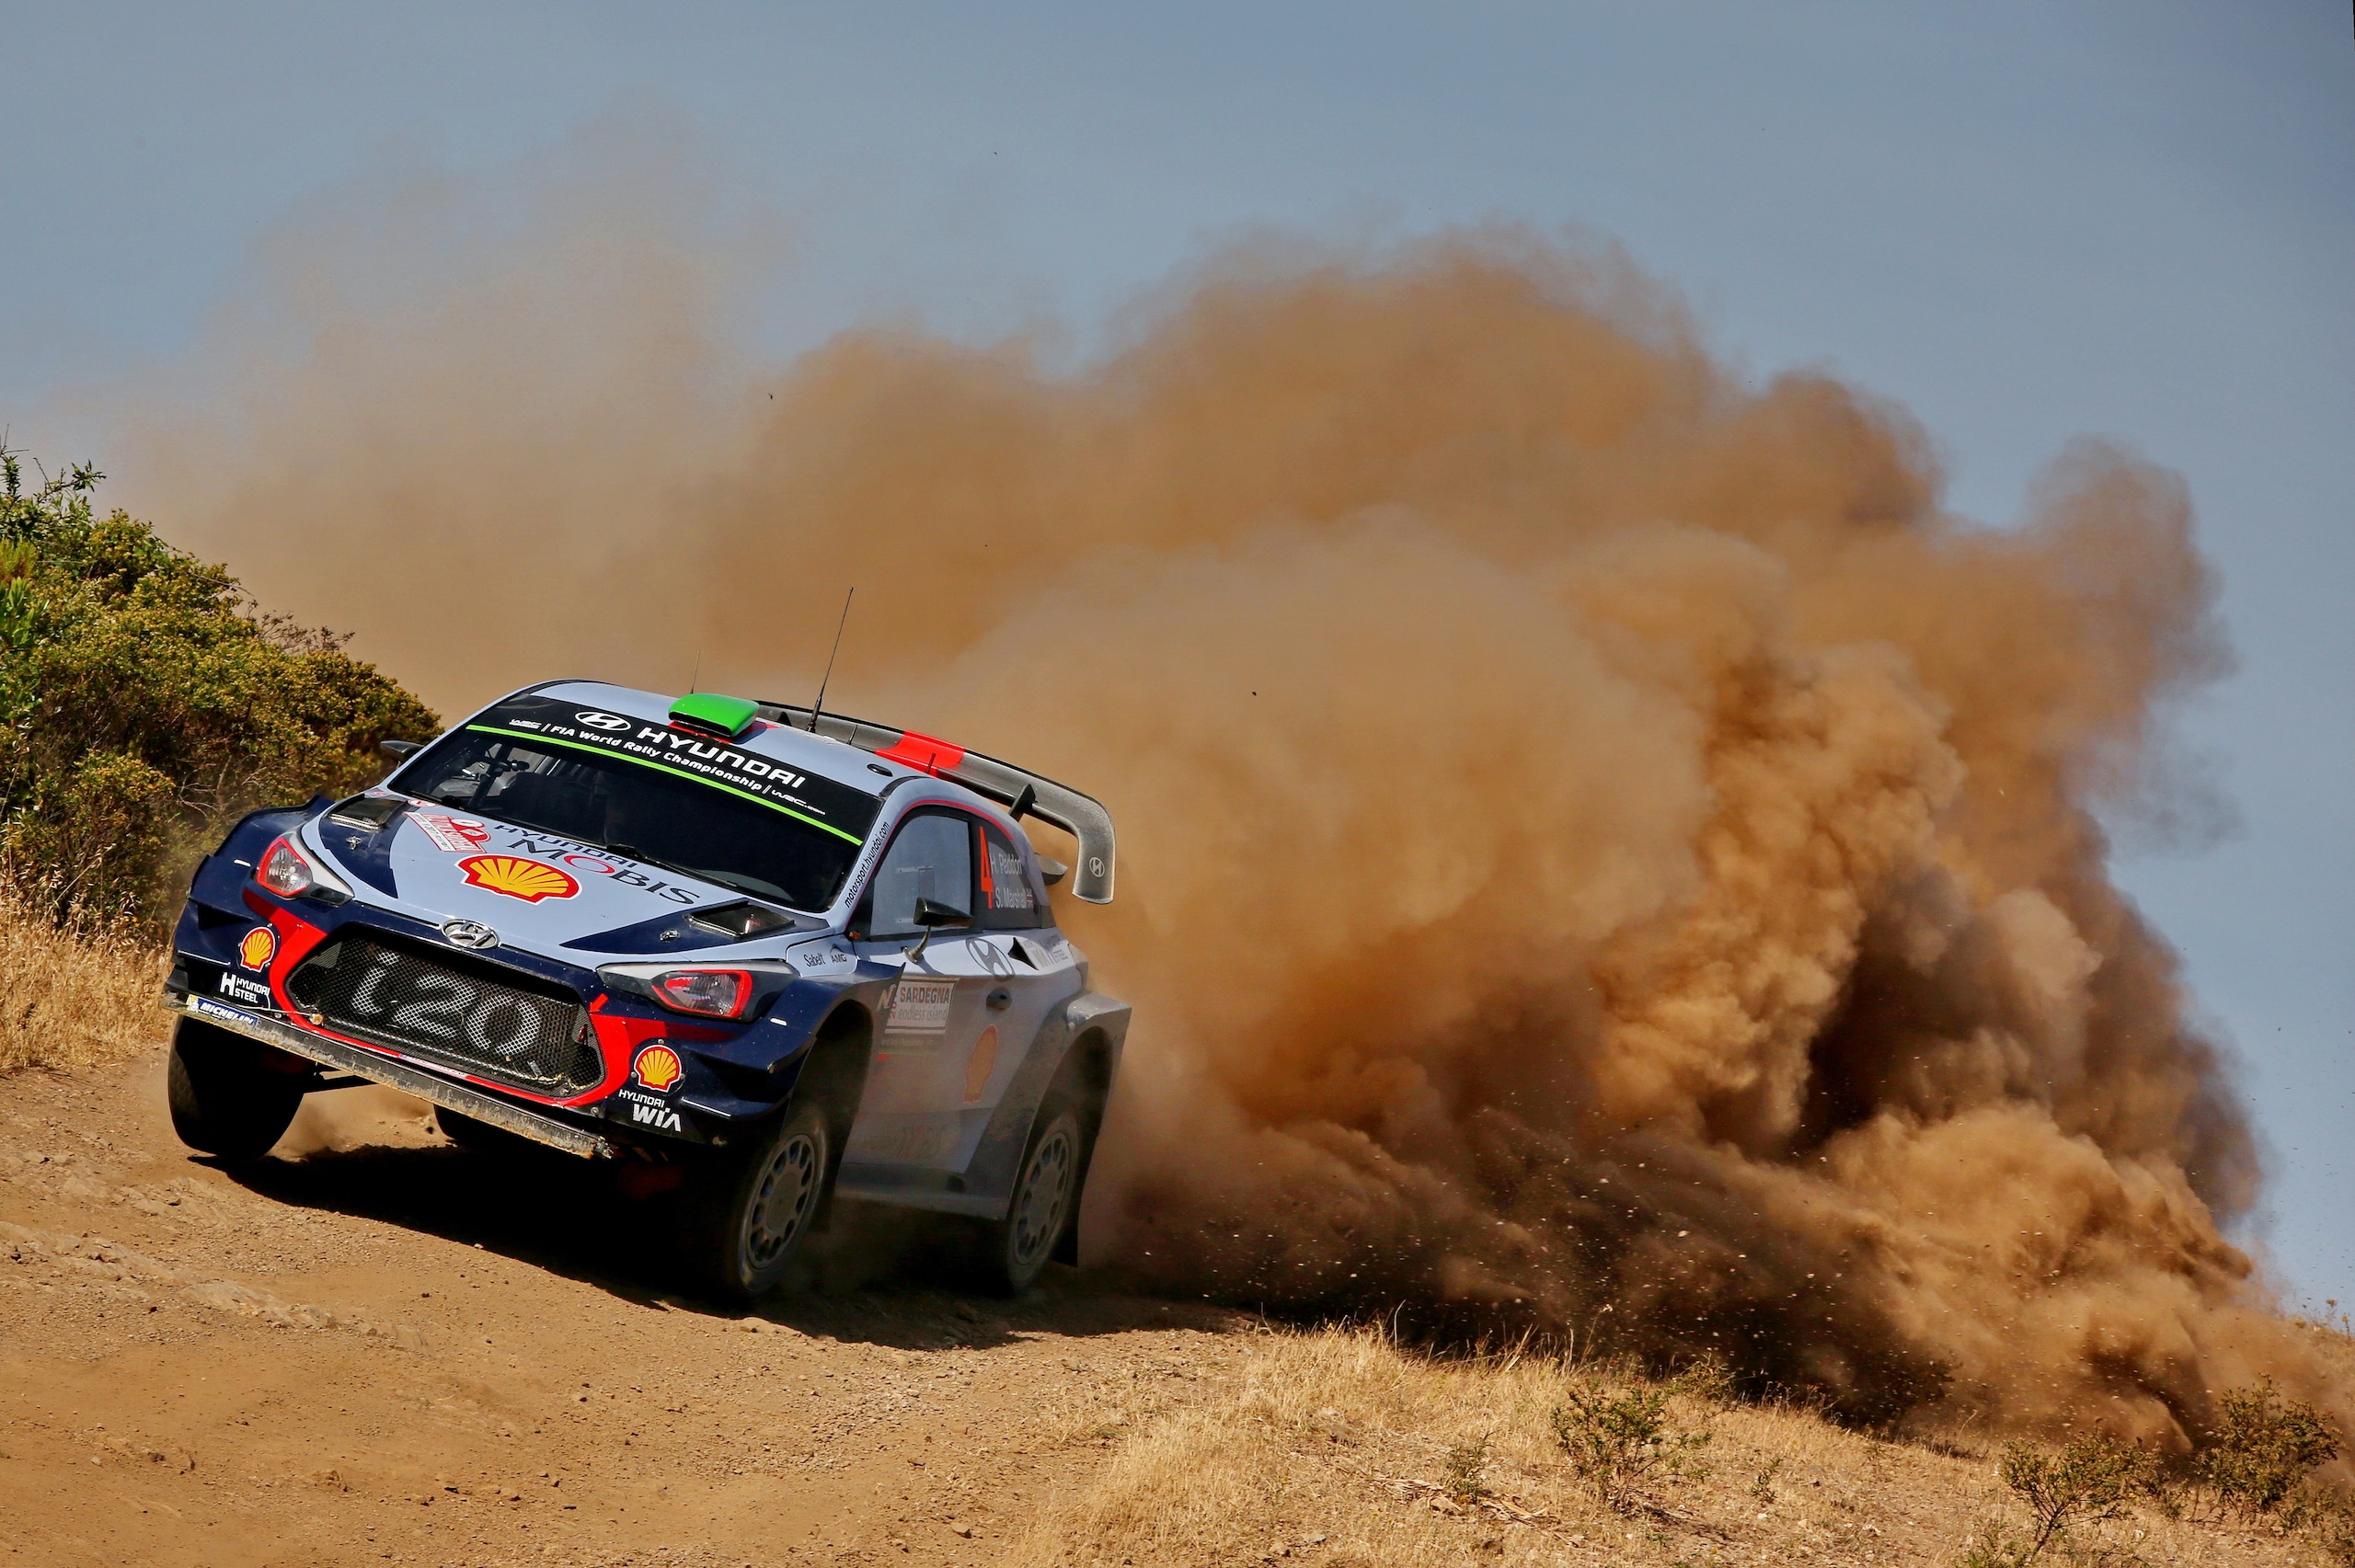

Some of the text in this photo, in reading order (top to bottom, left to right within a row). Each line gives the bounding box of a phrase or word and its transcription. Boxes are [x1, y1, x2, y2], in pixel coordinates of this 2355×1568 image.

[551, 726, 576, 737] FIA
[579, 730, 623, 748] World
[623, 741, 661, 758] Rally
[663, 750, 762, 791] Championship
[637, 727, 806, 788] HYUNDAI
[494, 825, 638, 868] HYUNDAI
[507, 839, 701, 905] MOBIS
[844, 821, 890, 908] motorsport.hyundai.com
[980, 826, 994, 909] 4
[998, 853, 1023, 875] Paddon
[995, 887, 1004, 909] S.
[831, 954, 847, 964] AMG
[235, 987, 258, 1003] STEEL
[236, 977, 270, 995] HYUNDAI
[900, 987, 950, 1004] SARDEGNA
[200, 1001, 255, 1024] MICHELIN
[618, 1089, 665, 1108] HYUNDAI
[632, 1104, 682, 1132] WIA
